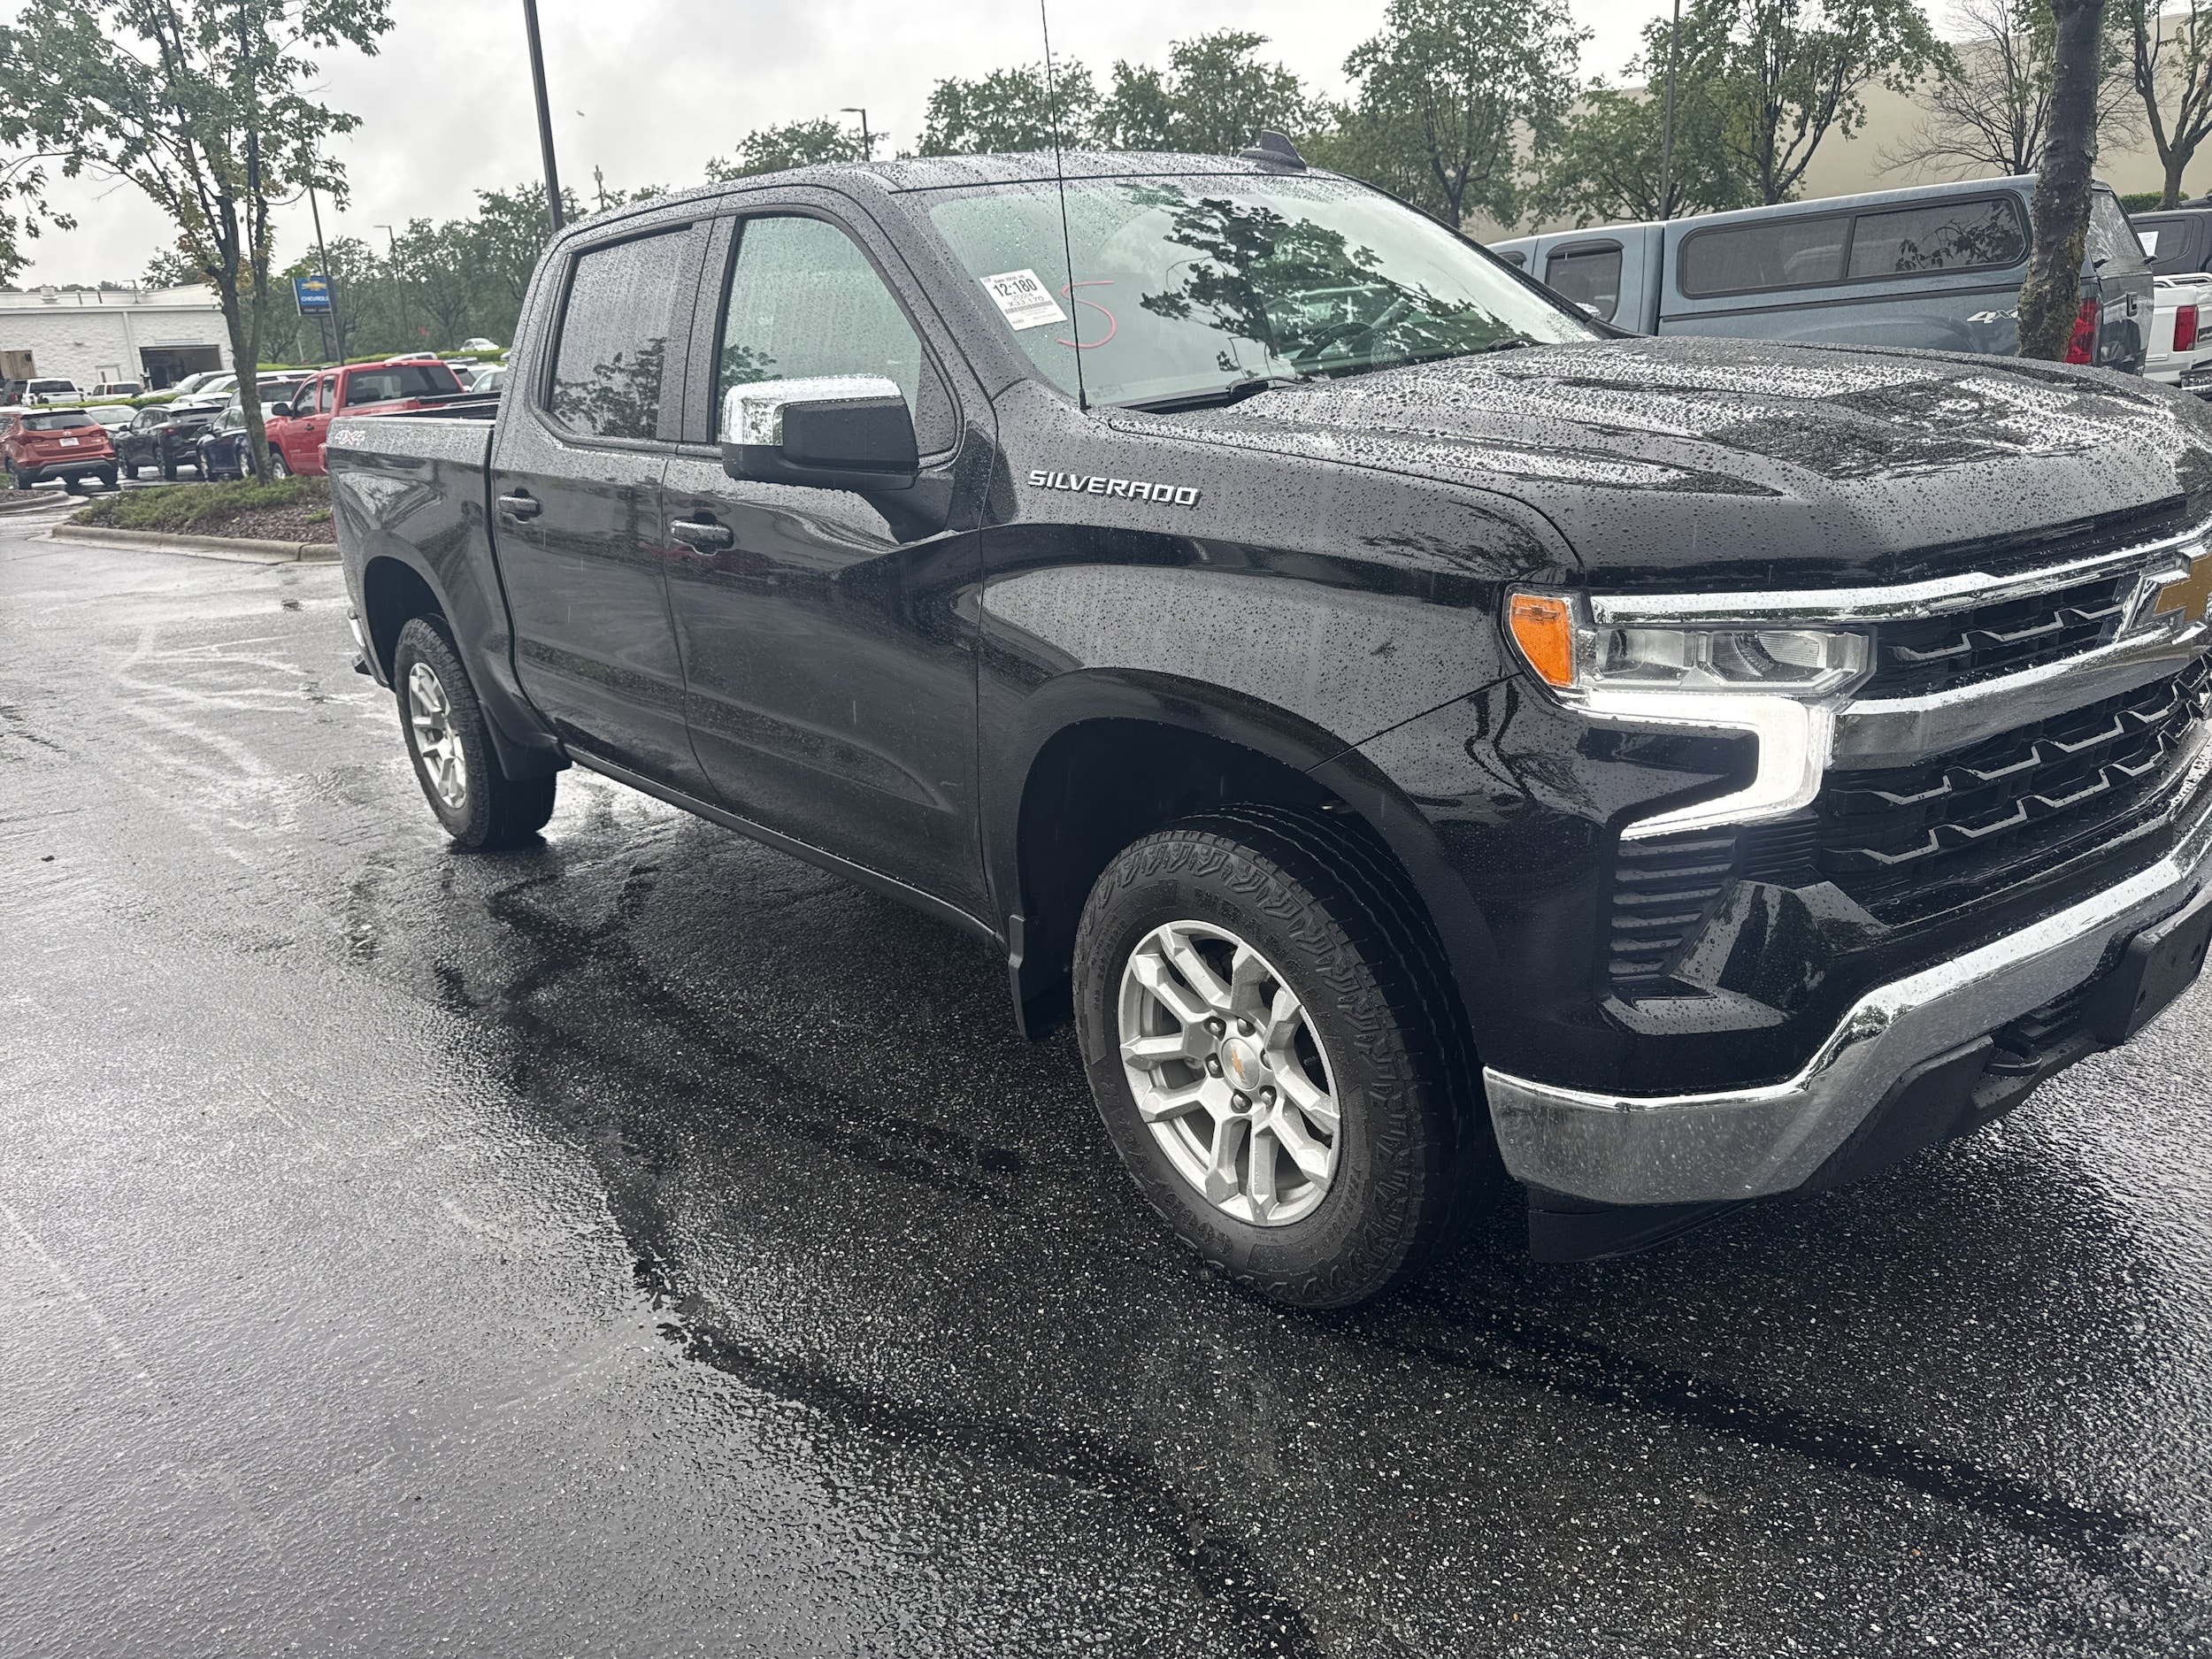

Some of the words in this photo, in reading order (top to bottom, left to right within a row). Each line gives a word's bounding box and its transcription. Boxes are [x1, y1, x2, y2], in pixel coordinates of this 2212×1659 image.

[993, 278, 1038, 297] 12:180
[1011, 292, 1033, 302] 2024
[1028, 469, 1200, 506] SILVERADO
